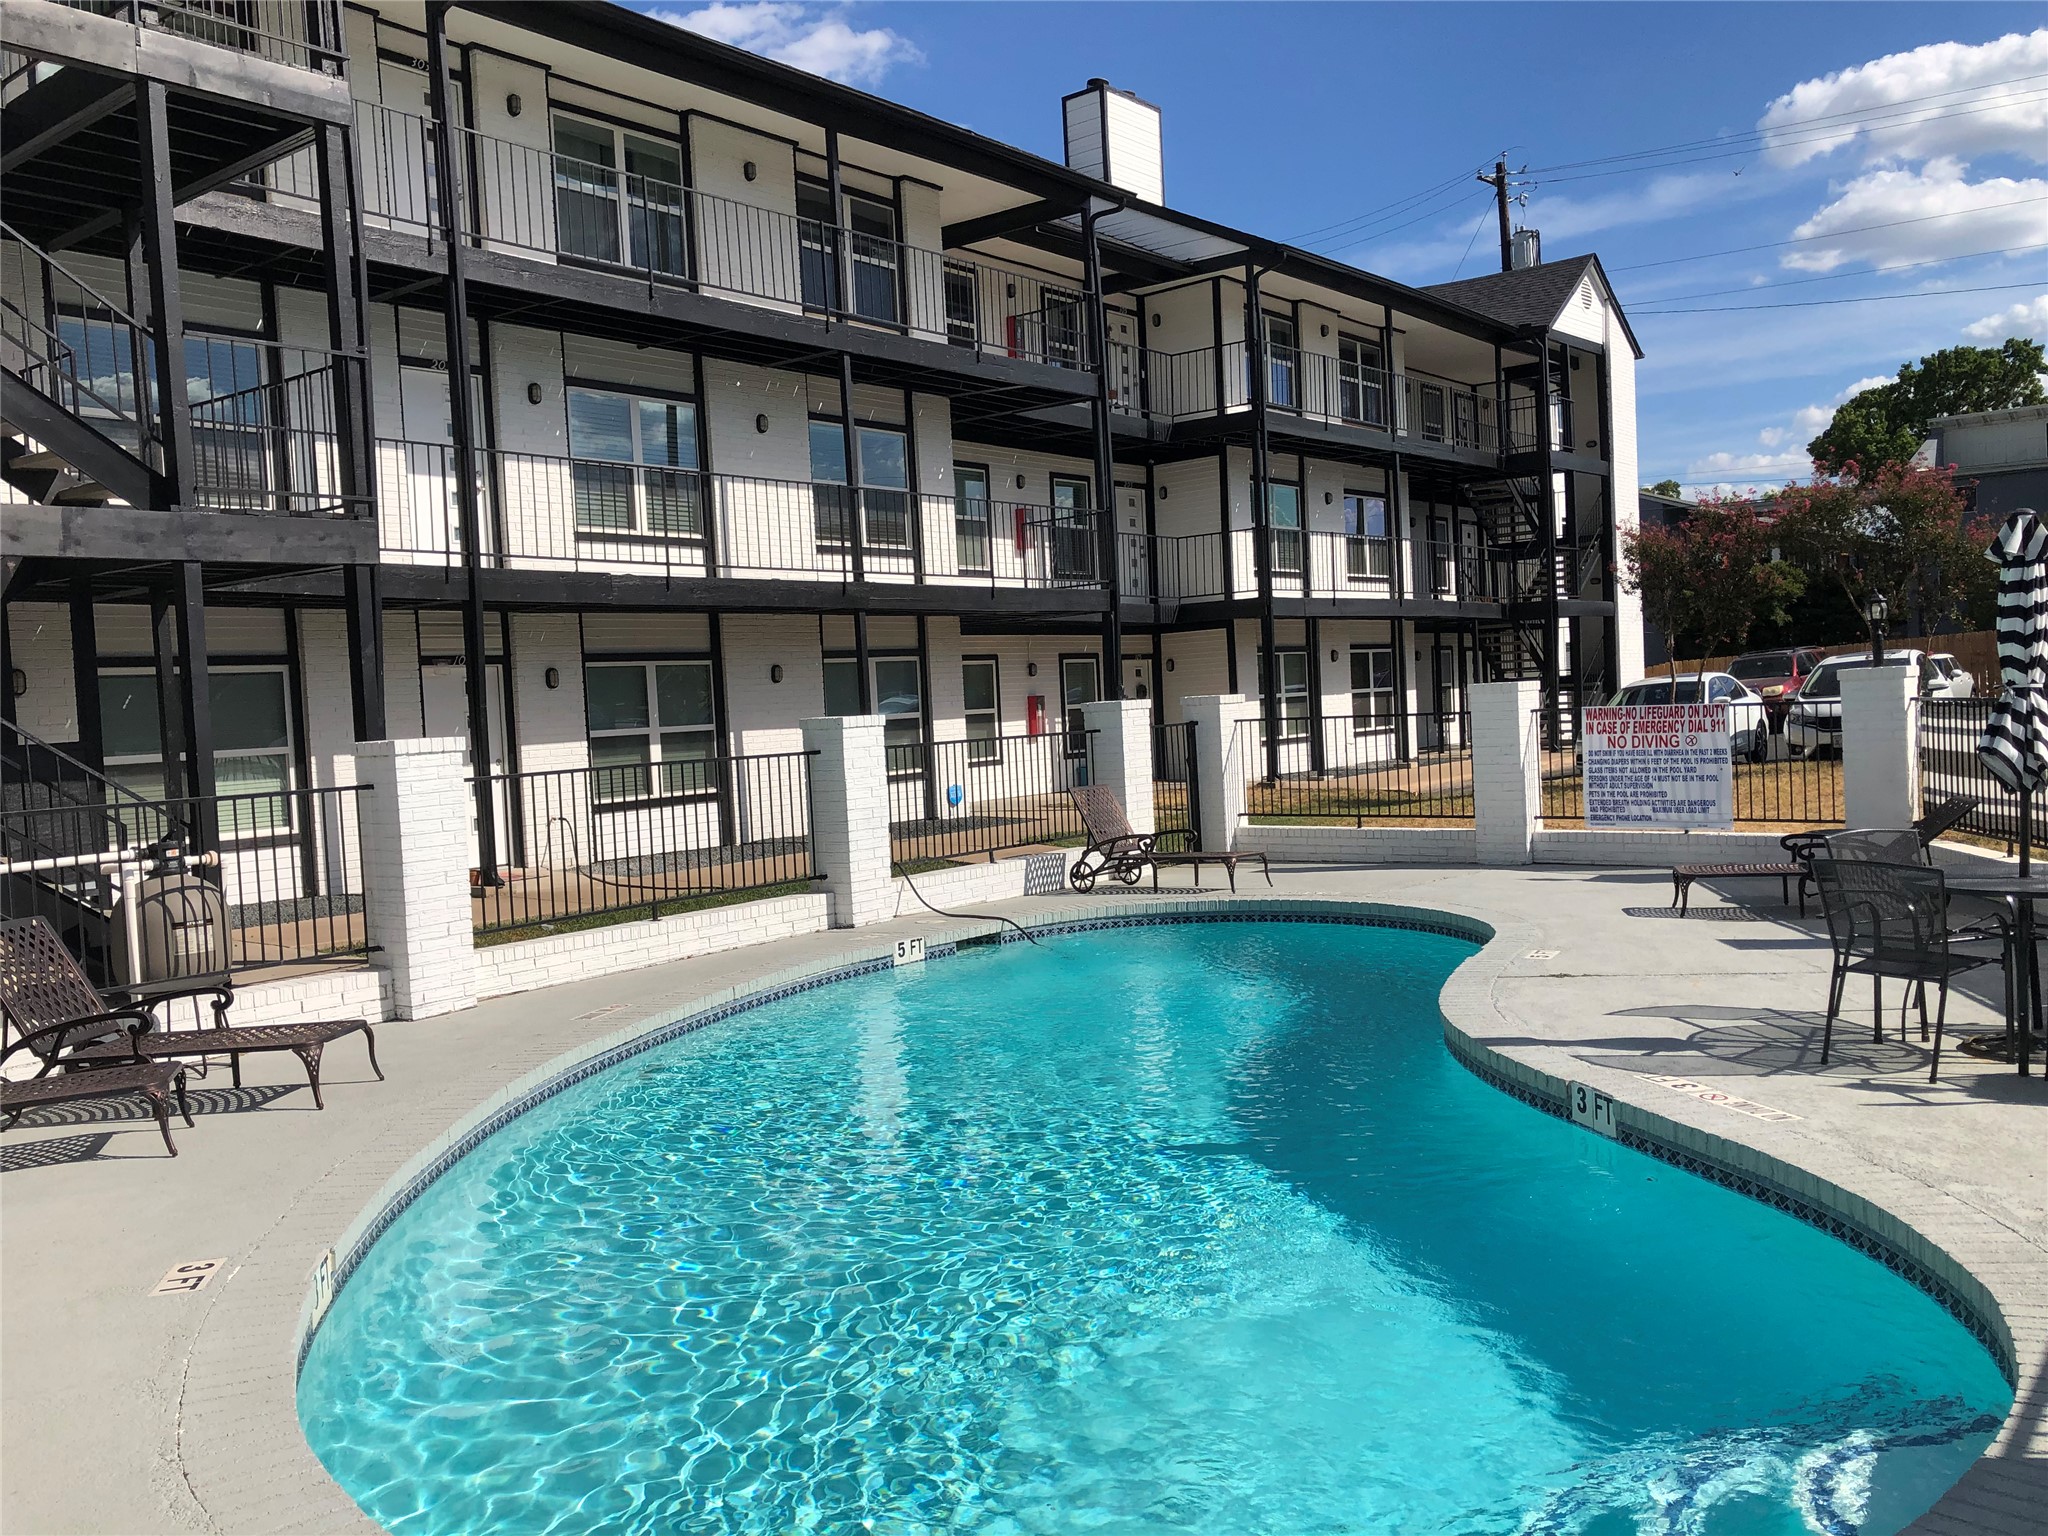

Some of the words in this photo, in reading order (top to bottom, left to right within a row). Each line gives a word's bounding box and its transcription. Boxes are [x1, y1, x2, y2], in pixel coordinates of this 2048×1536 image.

[1640, 705, 1685, 719] LIFEGUARD
[1688, 705, 1700, 718] ON
[1703, 704, 1726, 718] DUTY
[1586, 721, 1594, 735] IN
[1596, 721, 1617, 735] CASE
[1620, 721, 1630, 734] OF
[1633, 720, 1686, 734] EMERGENCY
[1688, 720, 1708, 733] DIAL
[1710, 719, 1726, 733] 911
[1608, 735, 1627, 748] NO
[1632, 735, 1680, 748] DIVING
[898, 942, 906, 958] 5
[910, 938, 922, 956] FT
[1577, 1086, 1586, 1114] 3
[1594, 1092, 1613, 1125] FT
[177, 1262, 216, 1272] 3
[159, 1275, 206, 1292] FT
[320, 1253, 330, 1299] FT
